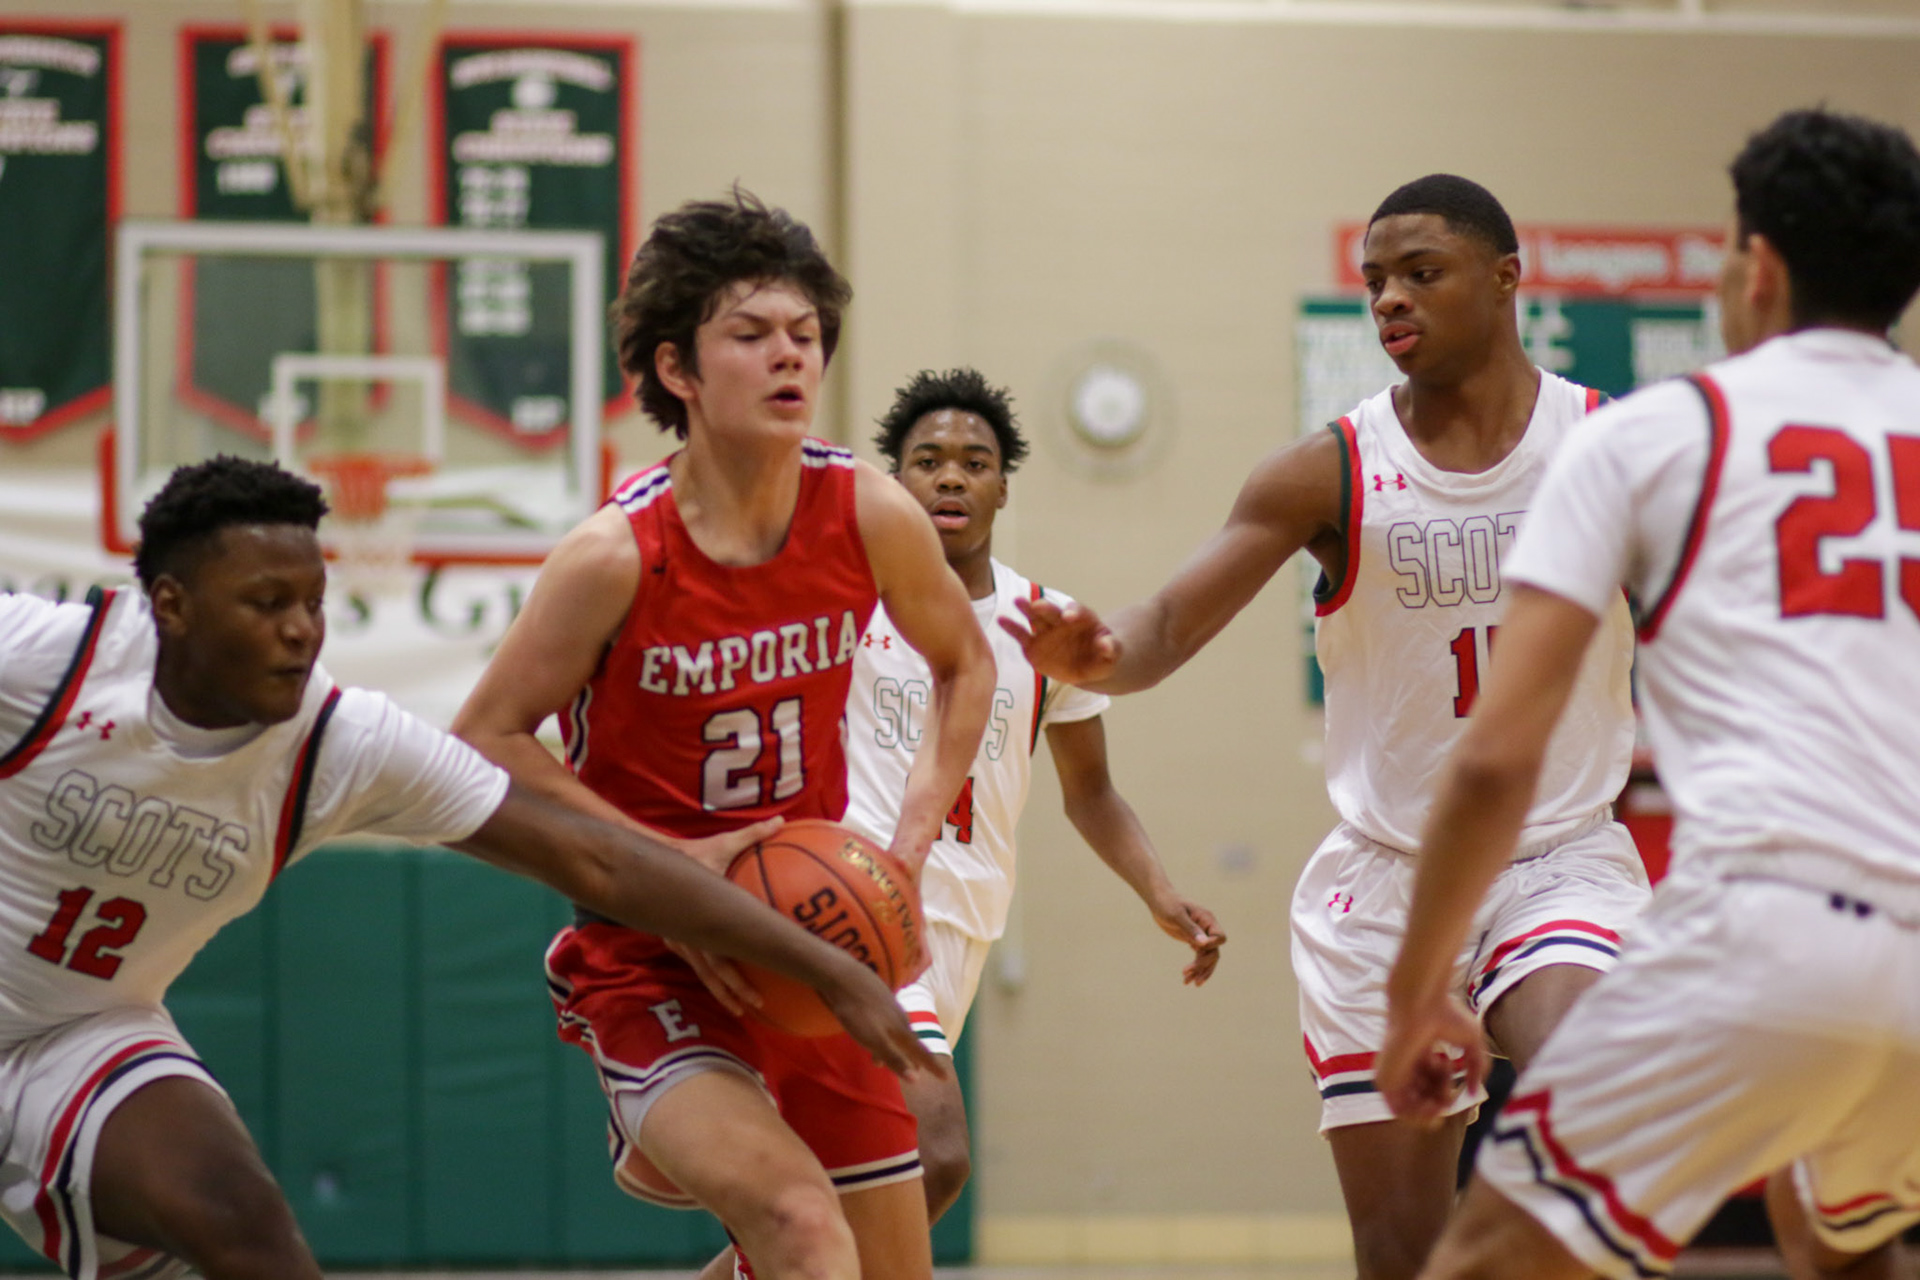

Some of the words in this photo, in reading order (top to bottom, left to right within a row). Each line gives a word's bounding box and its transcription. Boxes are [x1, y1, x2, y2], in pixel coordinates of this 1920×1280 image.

[638, 610, 858, 696] EMPORIA
[1450, 625, 1501, 718] 1
[702, 694, 807, 812] 21
[873, 677, 1014, 761] SCS
[30, 768, 249, 902] SCOTS
[920, 774, 975, 844] 4
[26, 885, 147, 982] 12
[647, 997, 701, 1043] E
